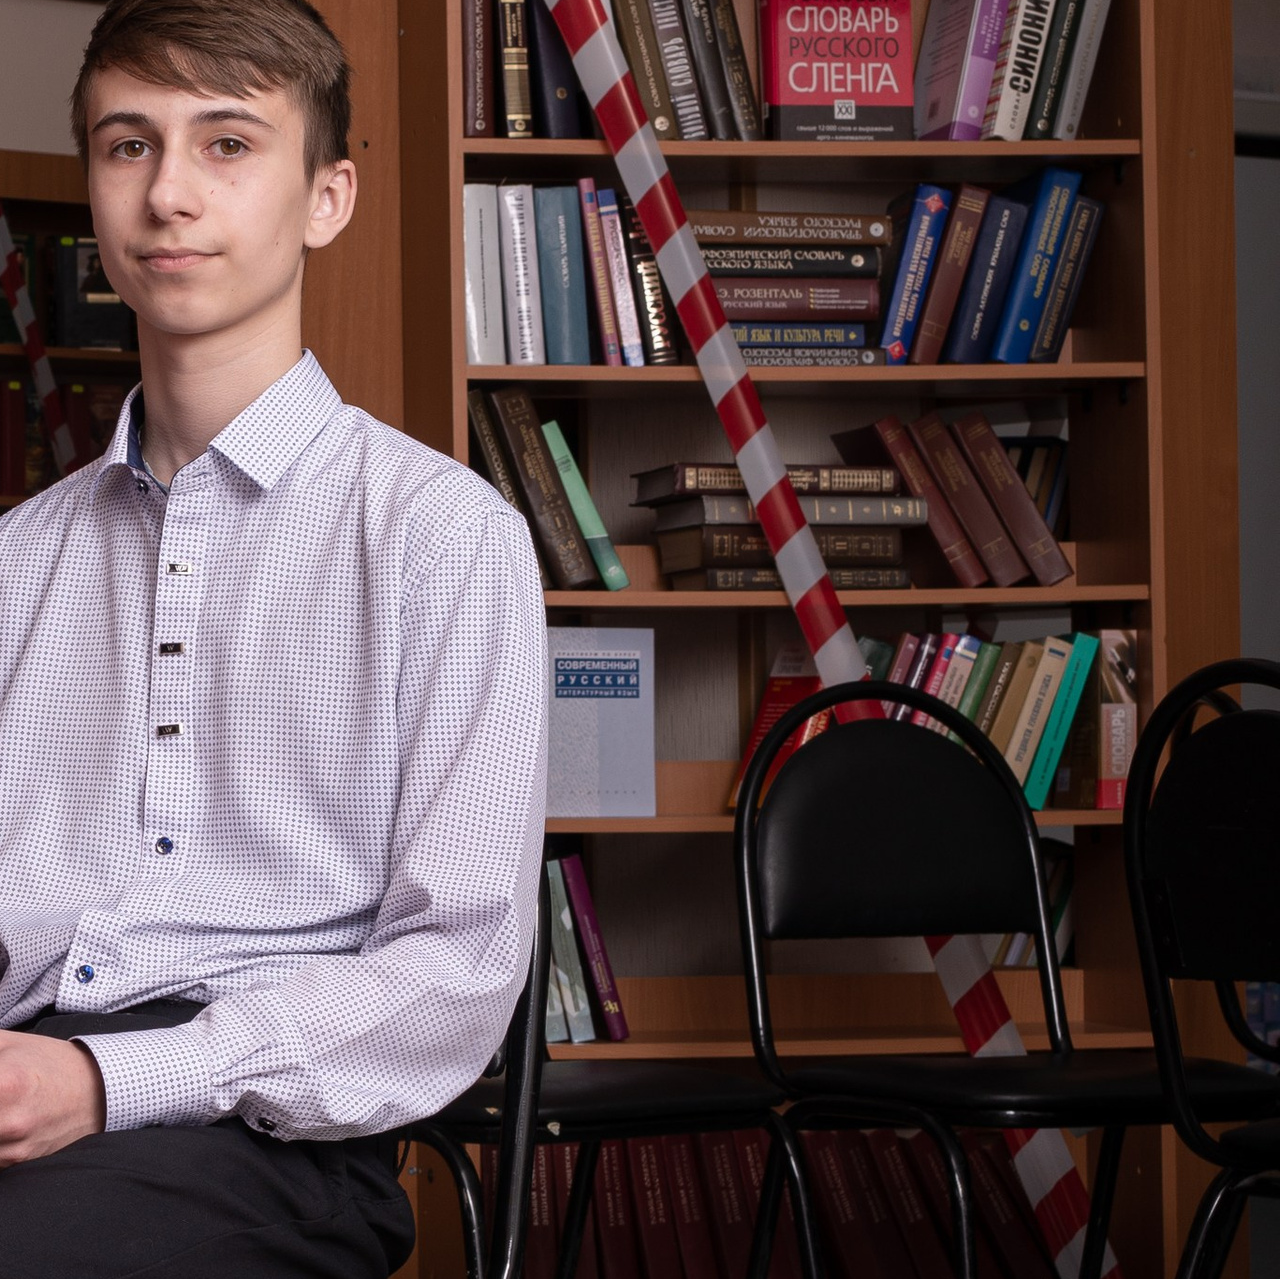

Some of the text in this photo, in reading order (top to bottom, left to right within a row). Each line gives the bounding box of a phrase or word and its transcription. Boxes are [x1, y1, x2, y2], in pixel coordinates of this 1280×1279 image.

[786, 6, 899, 33] СЛОВАРЬ
[475, 16, 484, 50] СЛОВАРЬ
[789, 37, 899, 58] РУССКОГО
[662, 36, 694, 88] СЛОВАРЬ
[788, 62, 899, 93] СЛЕНГА
[647, 78, 661, 108] СЛОВАРЬ
[669, 93, 707, 140] БОЛЬШОЙ
[757, 215, 862, 228] РУССКОГО ЯЗЫКА
[692, 225, 862, 240] ФРАЗЕОЛОГИЧЕСКИЙ СЛОВАР
[1029, 185, 1061, 277] ИНОСТРАННЫХ СЛОВ
[1033, 187, 1070, 299] СОВРЕМЕННЫЙ СЛОВАРЬ
[700, 248, 846, 261] РФОЭПИЧЕСКИЙ СЛОВАРЬ
[706, 259, 794, 270] ССКОГО ЯЗЫКА
[970, 312, 984, 341] СЛОВАРЬ
[999, 208, 1011, 229] СЛОВ
[733, 288, 804, 299] РОЗЕНТАЛЬ
[636, 260, 671, 350] РУССКИЙ
[722, 301, 788, 309] РУССКИЙ ЯЗЫК
[750, 328, 773, 343] ЯЗЫК
[783, 328, 822, 343] КУЛЬТУРА
[824, 328, 846, 343] РЕЧИ
[742, 347, 859, 358] СИНОНИМОВ РУССКОГО
[815, 356, 859, 367] СЛОВАРЬ
[557, 658, 637, 671] СОВРЕМЕННЫЙ
[557, 673, 638, 685] РУССКИЙ
[556, 689, 637, 697] ЛИТЕРАТУРНЫЙ ЯЗЫК
[1109, 708, 1127, 776] СЛОВАРЬ
